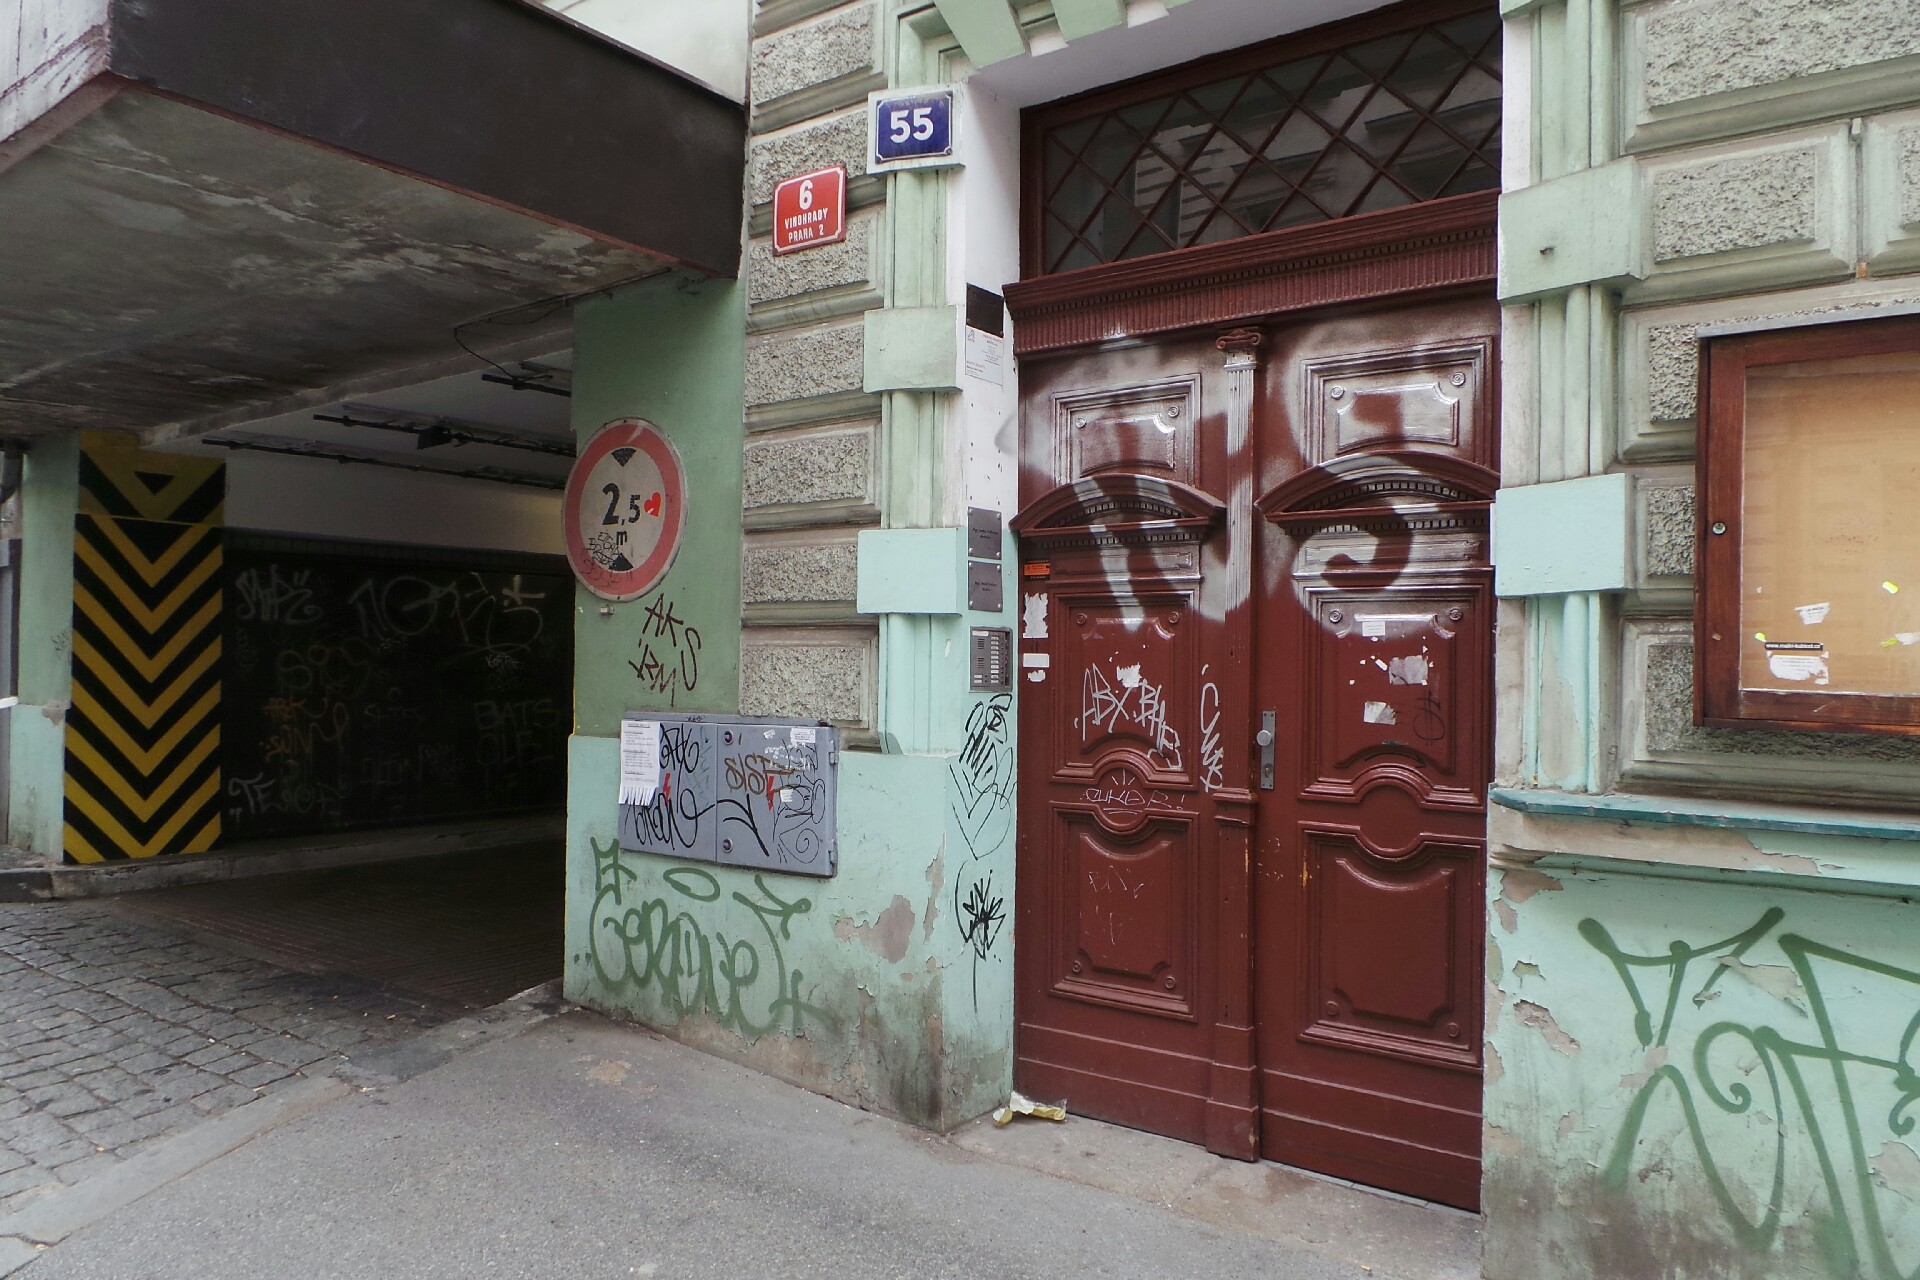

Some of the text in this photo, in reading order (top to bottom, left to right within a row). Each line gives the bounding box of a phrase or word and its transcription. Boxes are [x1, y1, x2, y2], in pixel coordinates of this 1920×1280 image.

[890, 107, 934, 144] 55
[799, 179, 813, 210] 6
[784, 208, 828, 230] VINOHRADY
[788, 224, 824, 243] PRAHA 2
[602, 482, 641, 526] 2,5
[616, 530, 628, 546] m
